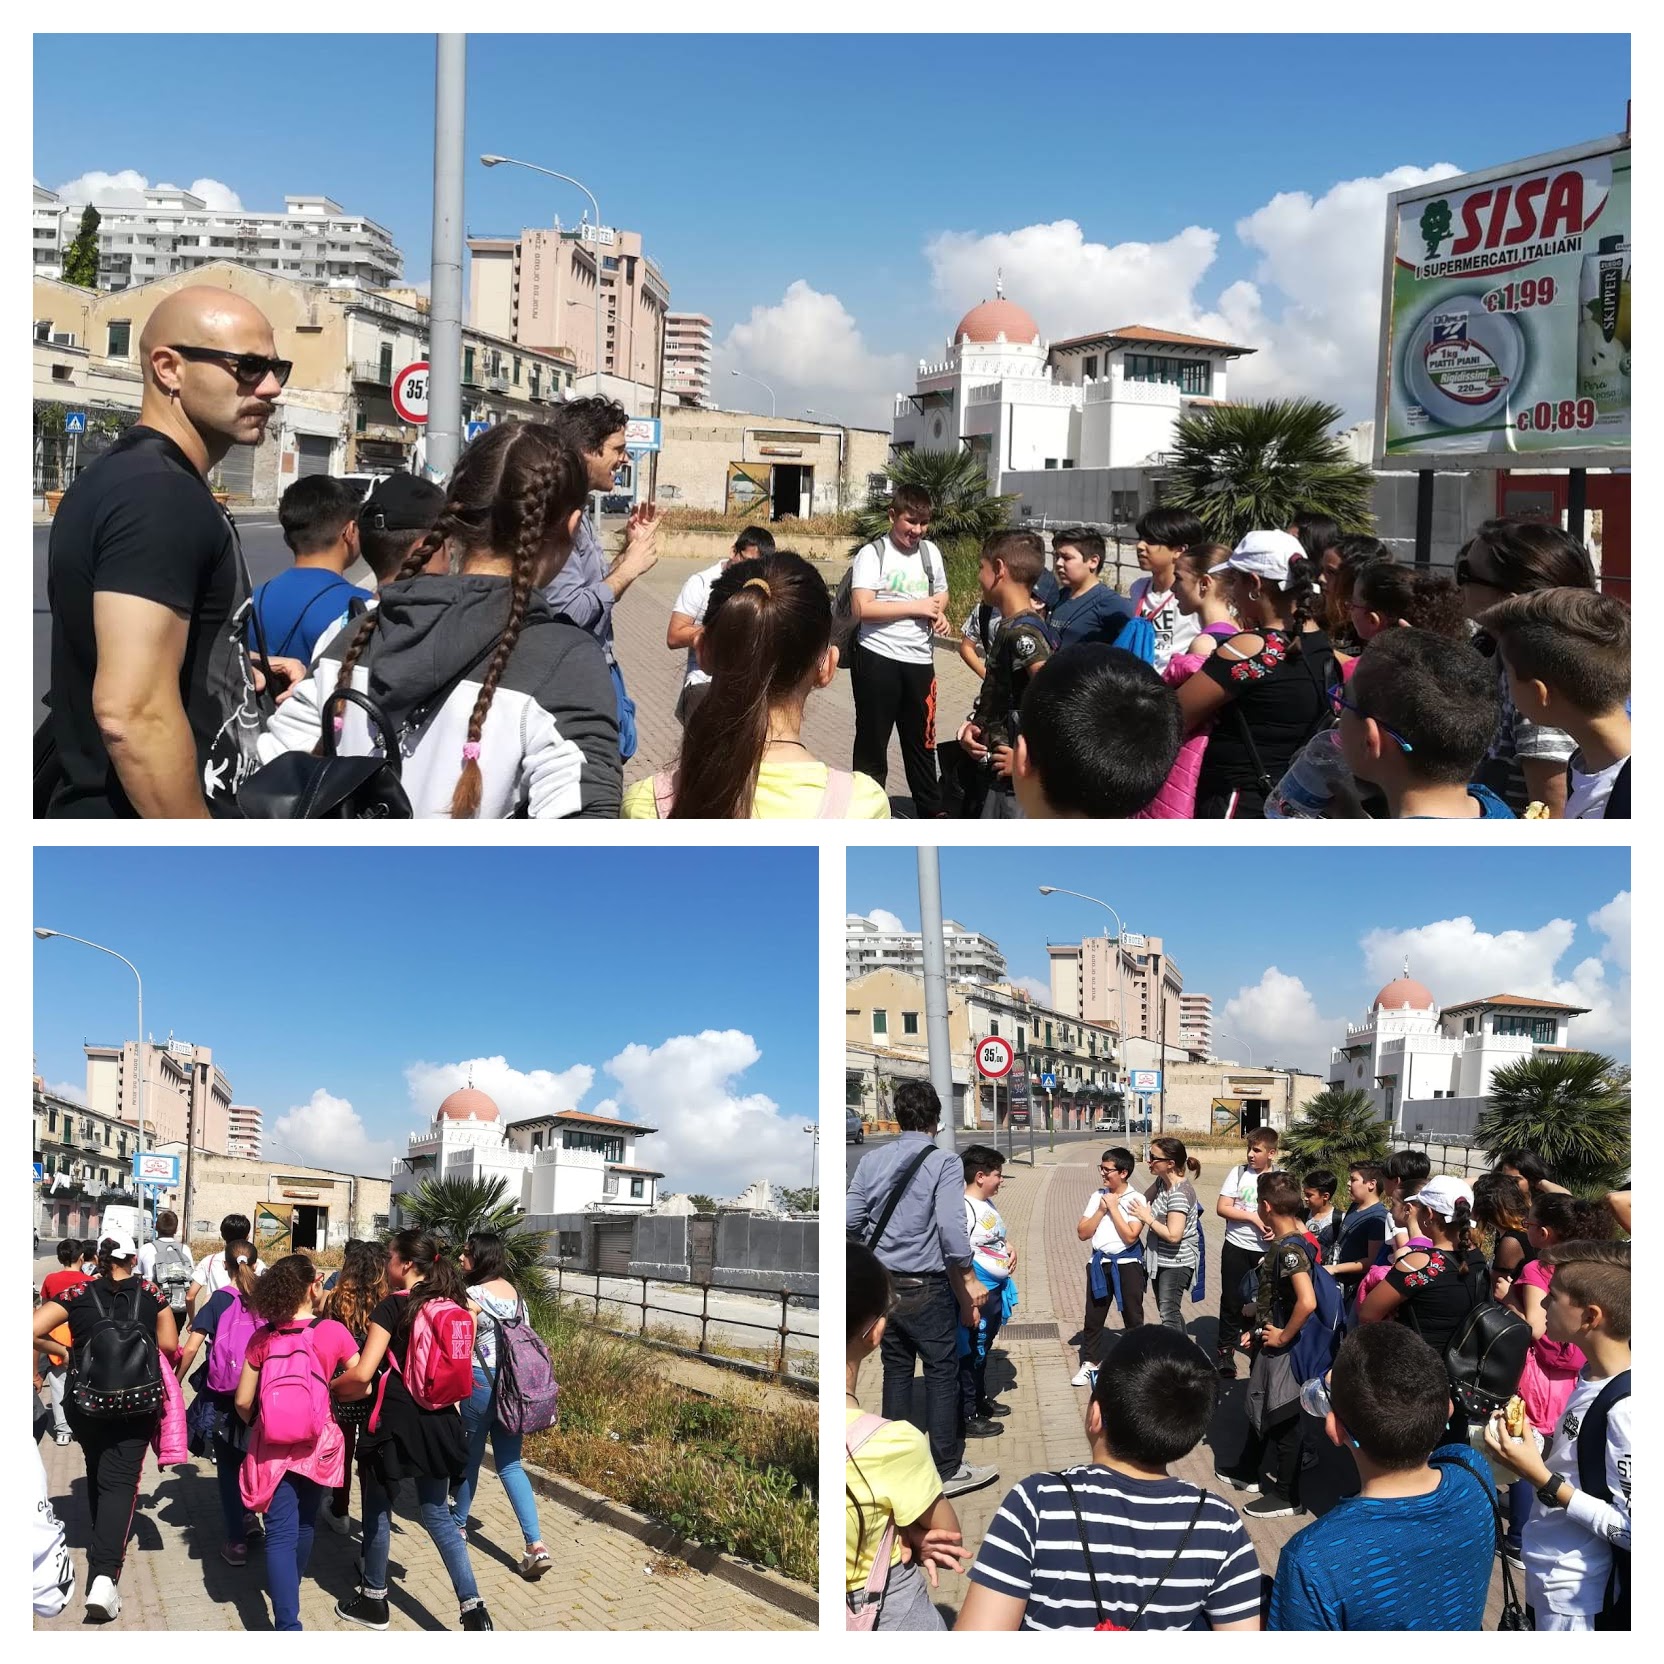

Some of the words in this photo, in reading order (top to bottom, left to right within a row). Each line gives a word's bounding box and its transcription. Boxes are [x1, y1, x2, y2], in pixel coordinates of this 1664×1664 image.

[1451, 170, 1583, 256] SISA
[590, 228, 613, 243] HTEL
[1416, 265, 1421, 278] I
[1423, 249, 1519, 277] SUPERMERCATI
[1522, 237, 1582, 261] ITALIANI
[1604, 270, 1616, 330] SKIPPER
[1429, 358, 1455, 368] PIATTI
[1456, 356, 1480, 366] PIANI
[1440, 368, 1490, 384] Rigidissimi
[174, 1043, 192, 1055] HOTEL
[984, 1048, 1004, 1063] 35,00
[451, 1320, 472, 1340] NI
